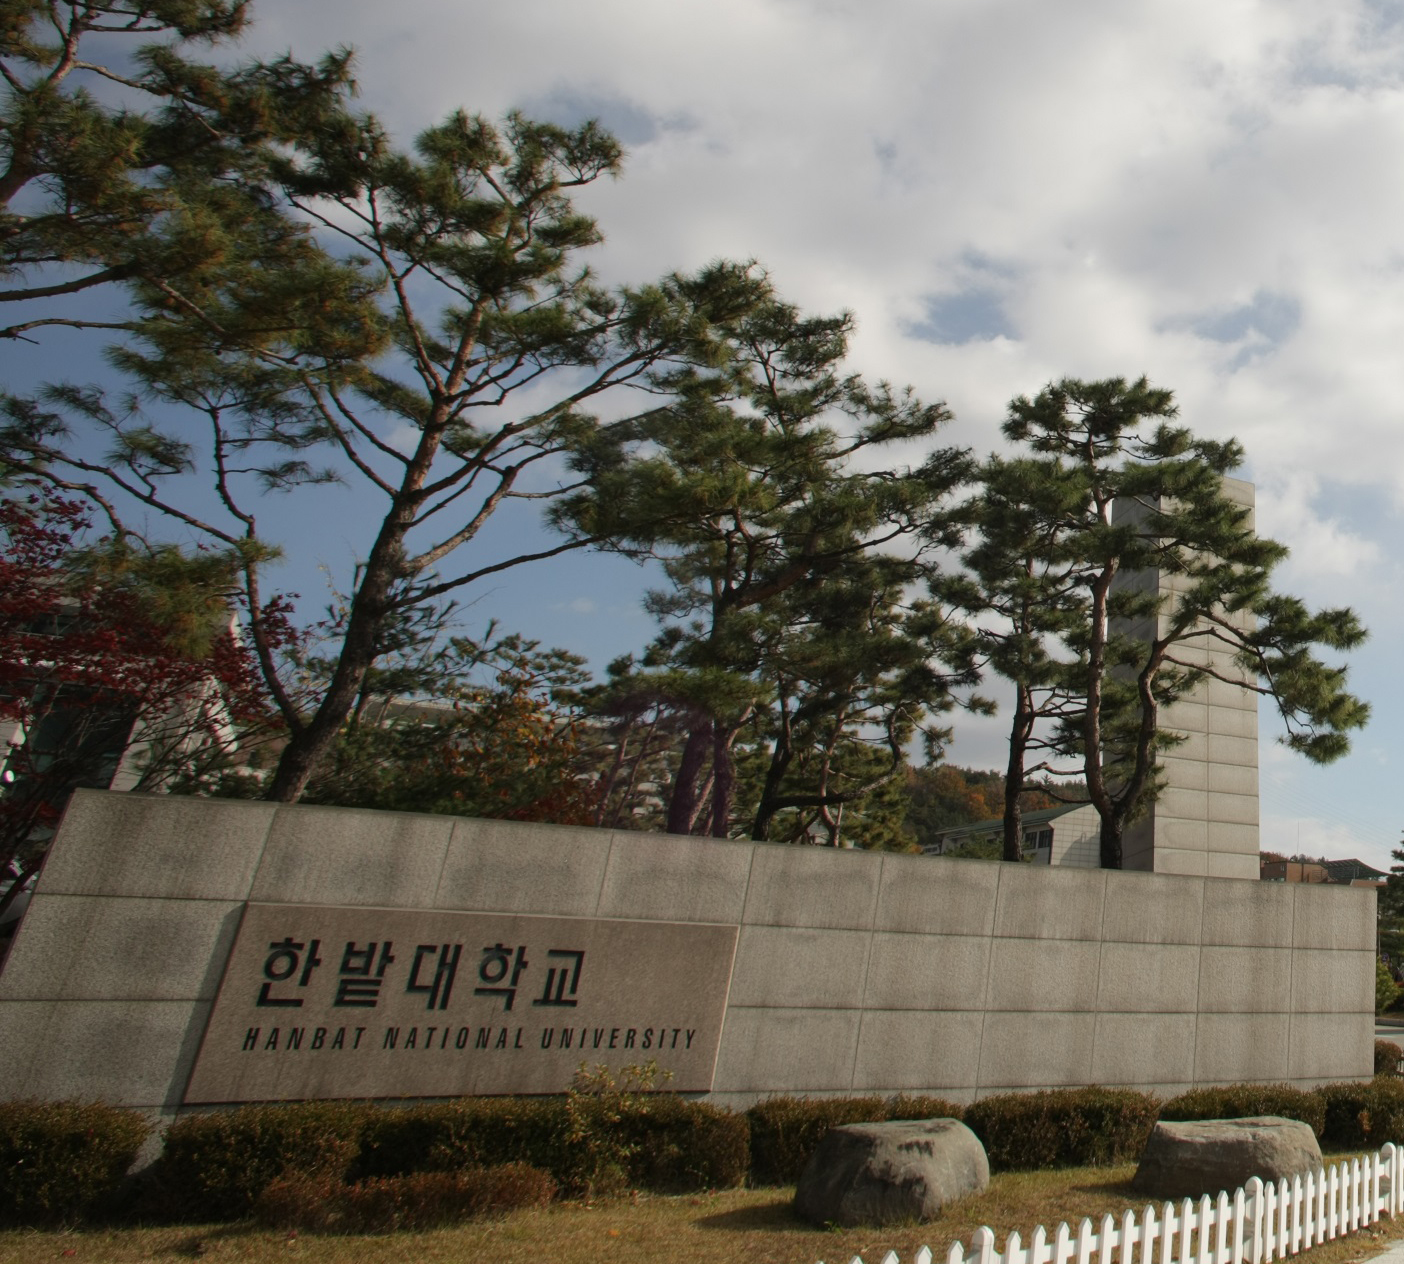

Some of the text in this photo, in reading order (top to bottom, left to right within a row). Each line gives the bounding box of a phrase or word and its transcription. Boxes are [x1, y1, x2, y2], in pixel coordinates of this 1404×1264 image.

[256, 937, 586, 1011] 한밭대학교
[242, 1027, 697, 1051] HANBAT NATIONAL UNIVERSITY
